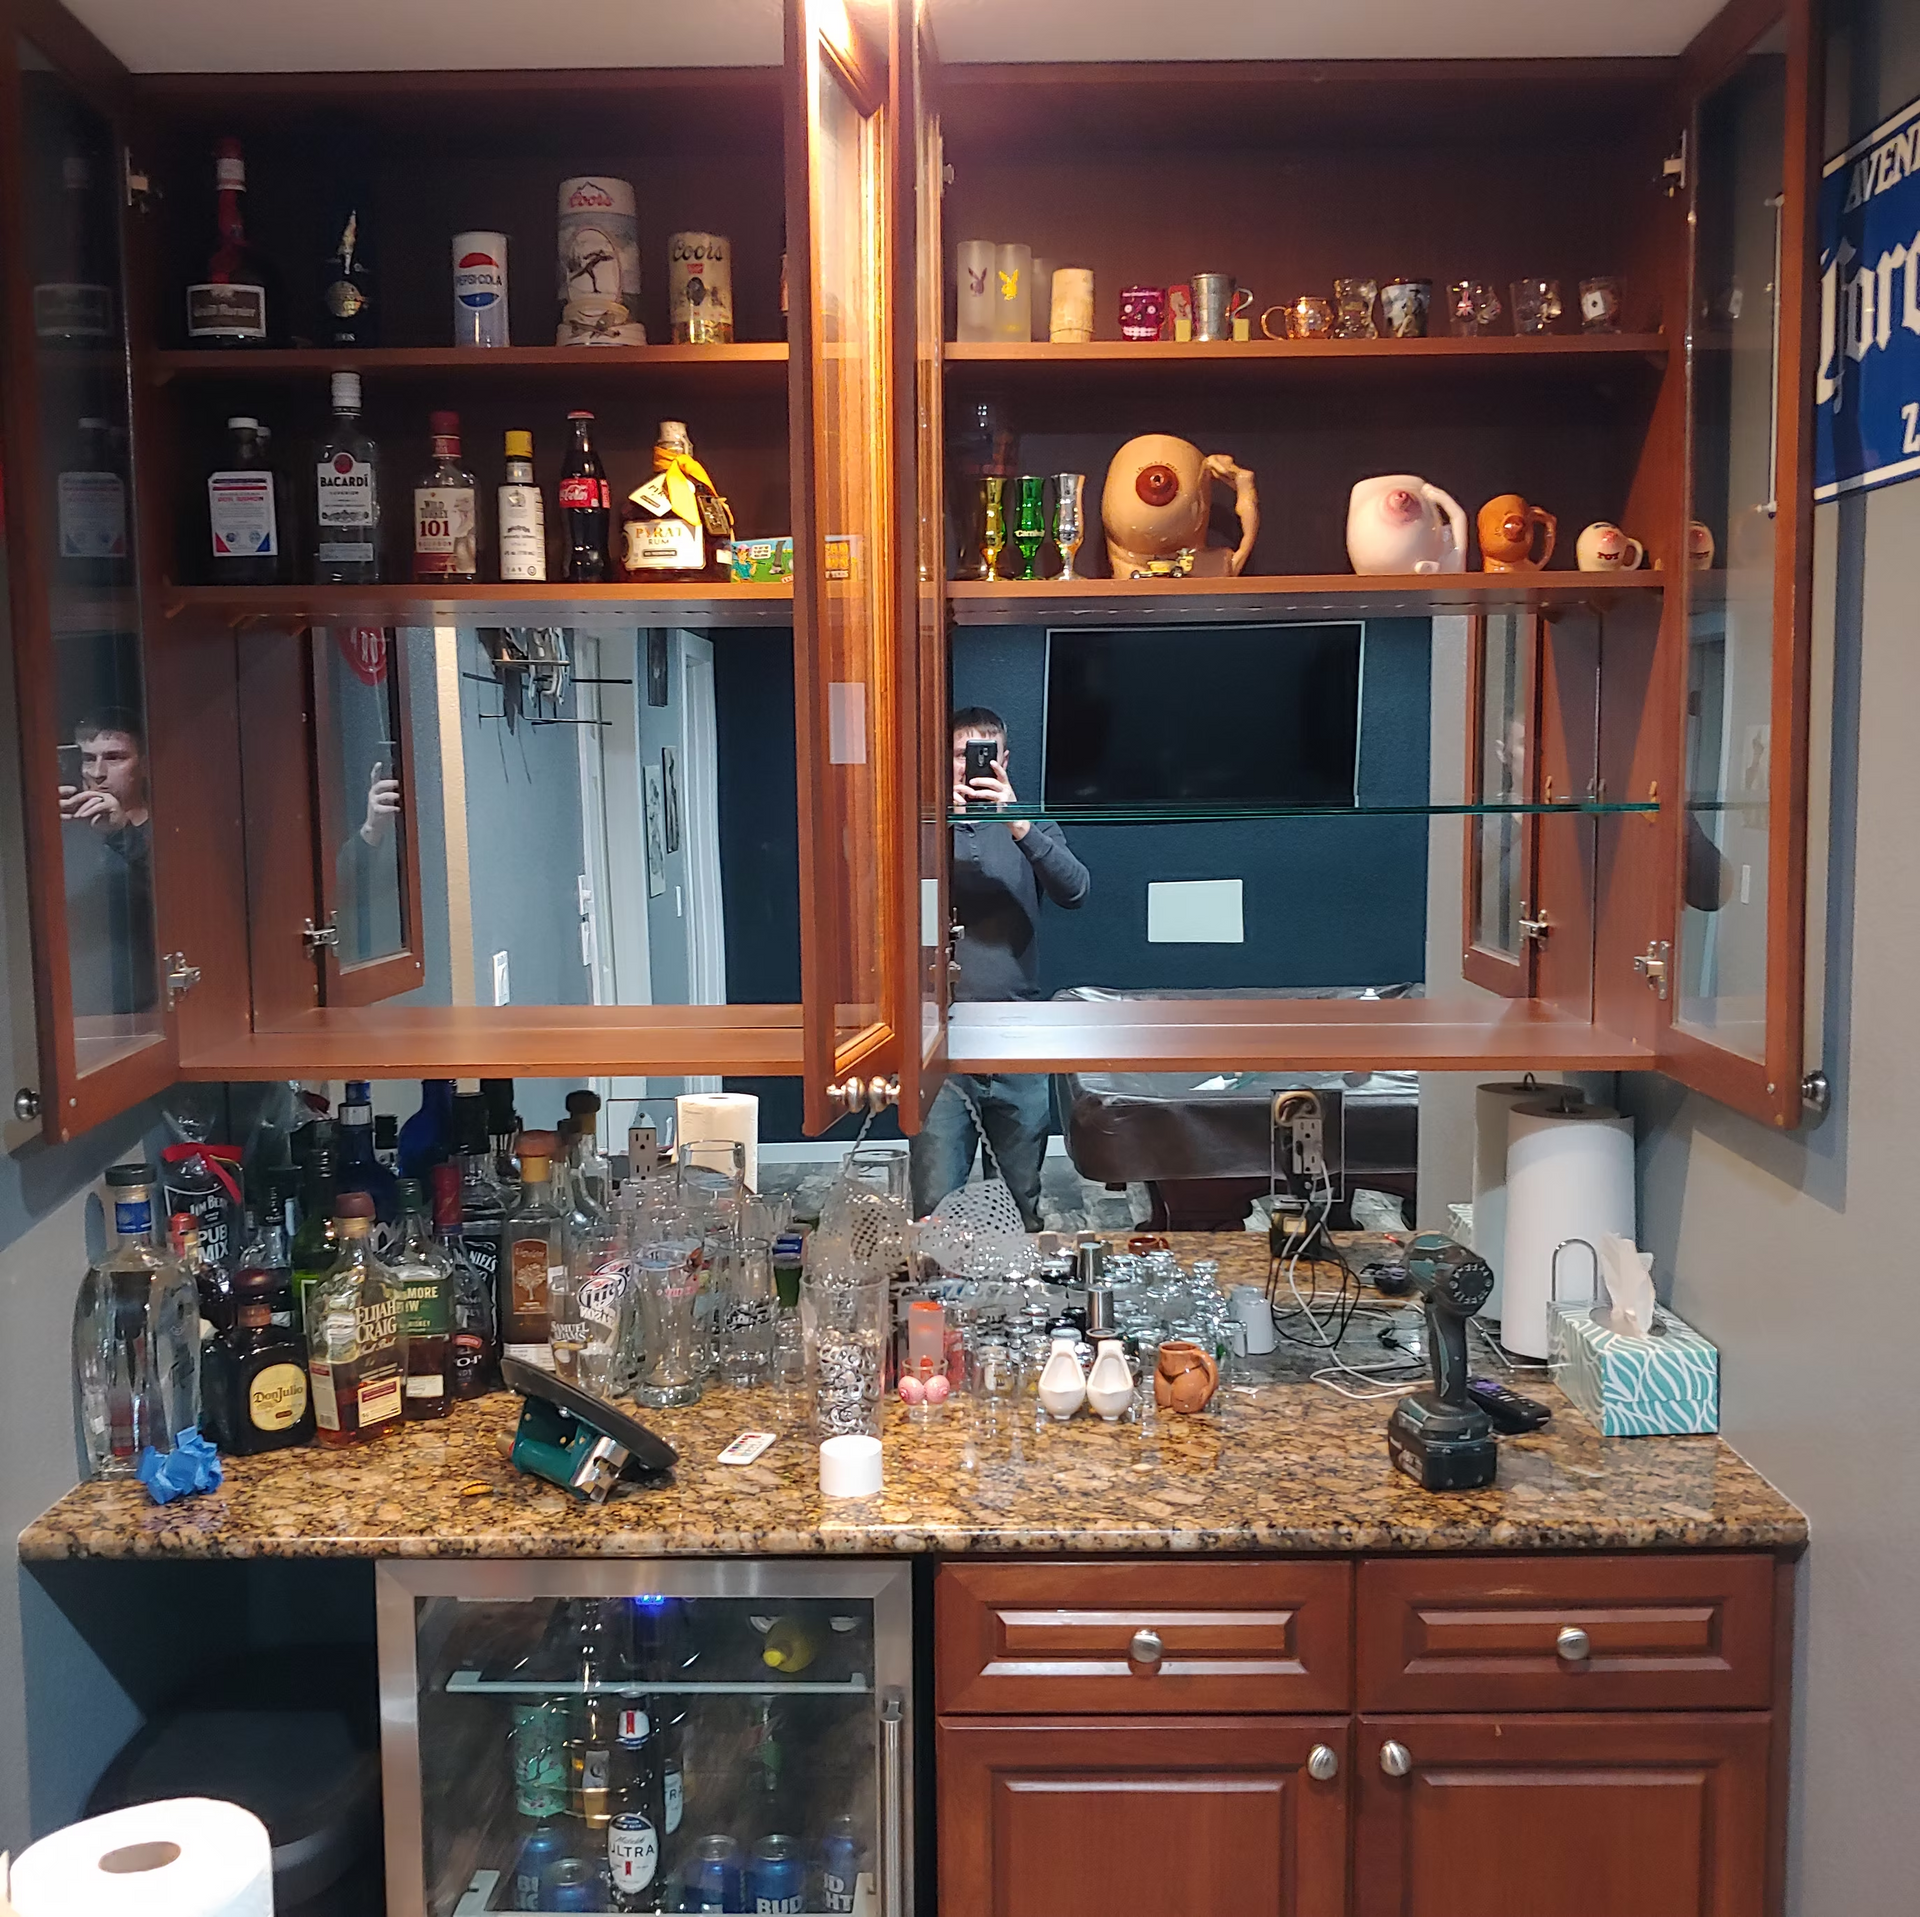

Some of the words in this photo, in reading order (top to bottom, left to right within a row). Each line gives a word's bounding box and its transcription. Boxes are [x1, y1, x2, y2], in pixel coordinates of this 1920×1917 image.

[673, 240, 723, 261] Coors
[320, 473, 369, 487] BACARDÍ
[420, 519, 450, 537] 101
[635, 526, 682, 539] PYRAT
[198, 1223, 228, 1243] PUB
[198, 1239, 229, 1264] MIX
[355, 1299, 398, 1326] ELIJAH
[355, 1316, 398, 1344] CRAIG
[550, 1320, 590, 1333] SAMUEL
[554, 1331, 587, 1341] ADAMS
[756, 1895, 803, 1914] BUD
